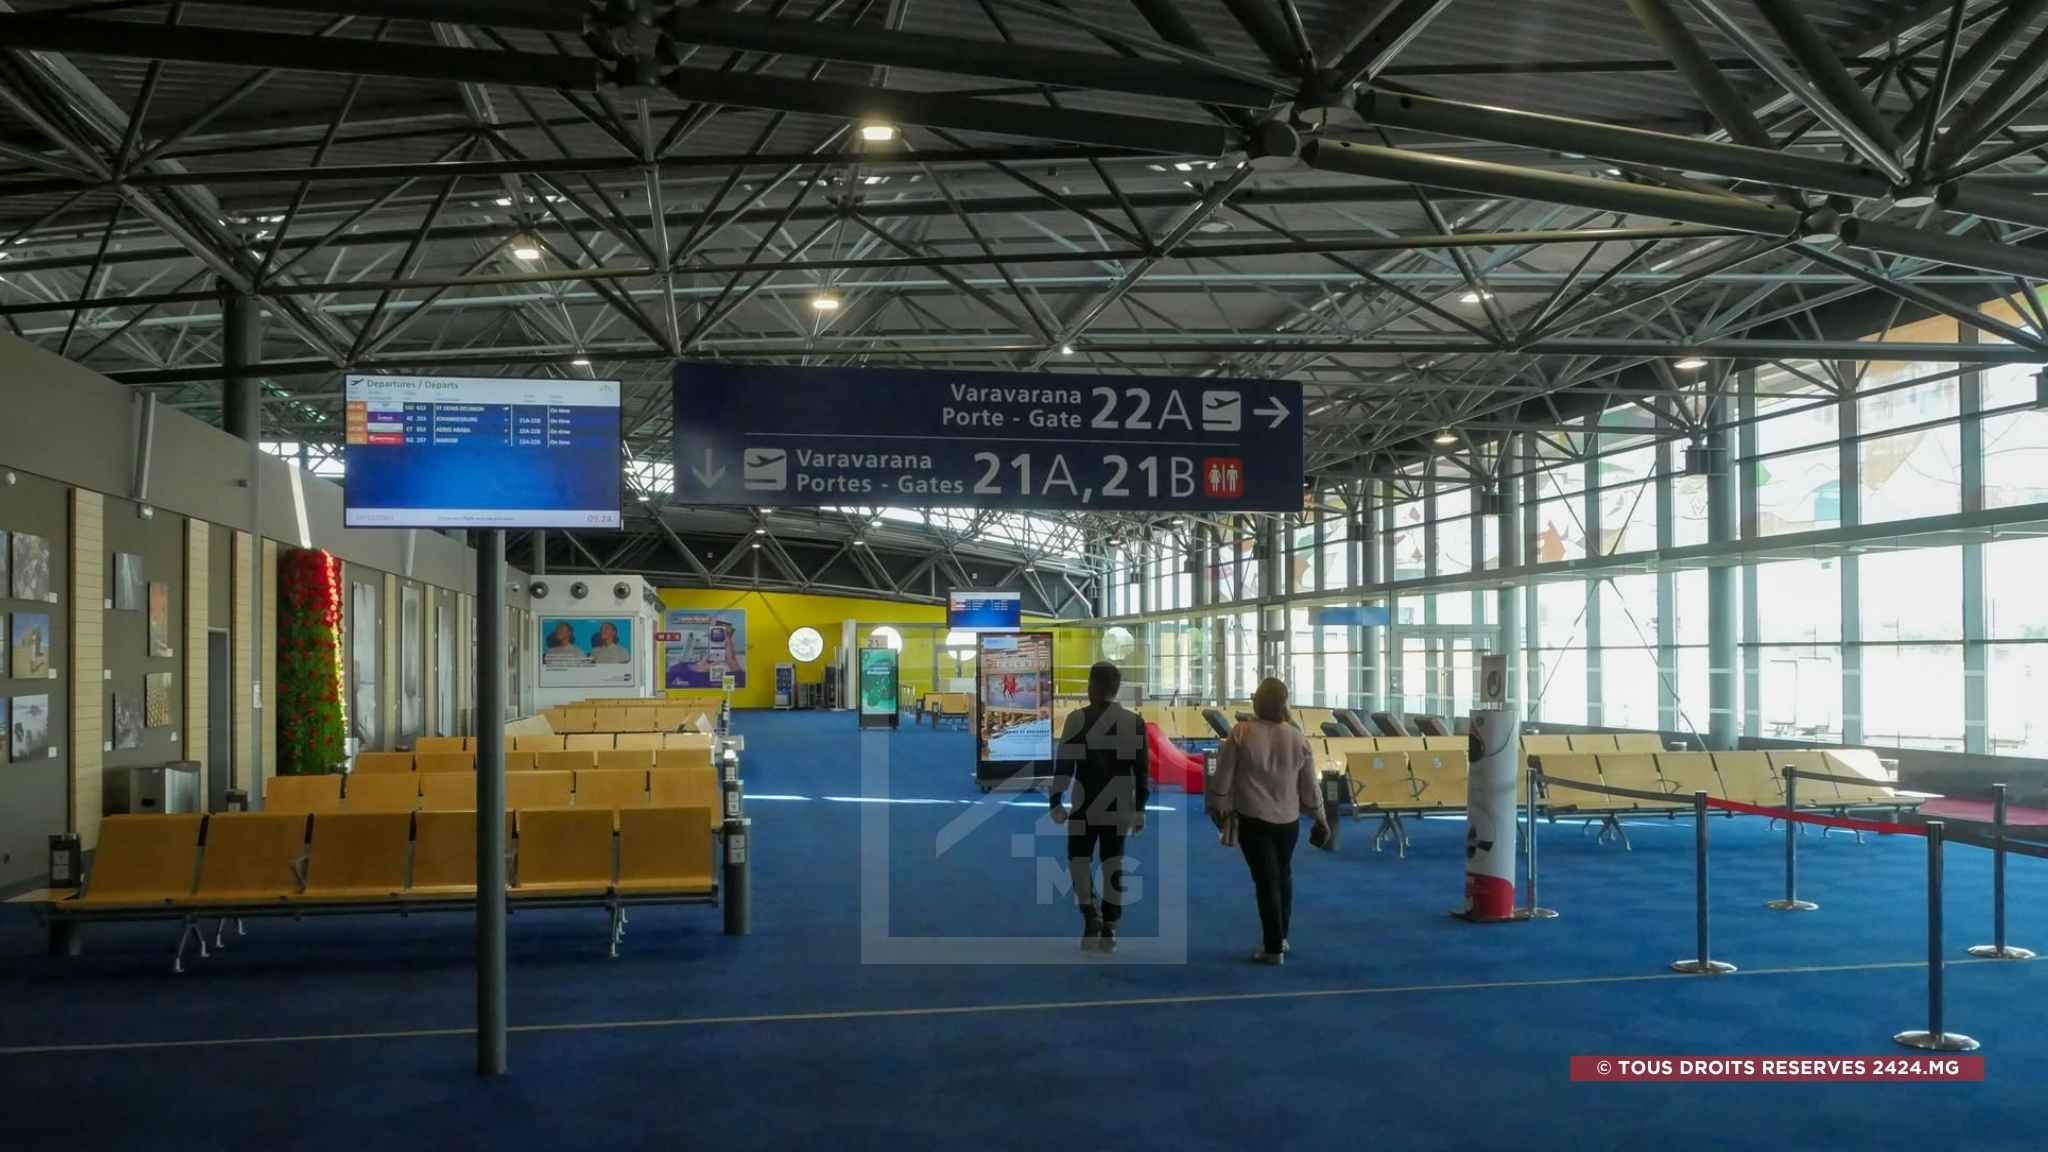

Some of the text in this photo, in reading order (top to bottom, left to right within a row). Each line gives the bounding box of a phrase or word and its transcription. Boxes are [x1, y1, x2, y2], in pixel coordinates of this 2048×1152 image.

[367, 379, 416, 391] Departures
[950, 384, 1082, 404] Varavarana
[942, 407, 1004, 426] Porte
[1029, 409, 1082, 429] Gate
[1090, 387, 1193, 431] 22A
[797, 449, 932, 471] Varavarana
[797, 474, 872, 493] Portes
[898, 476, 964, 494] Gates
